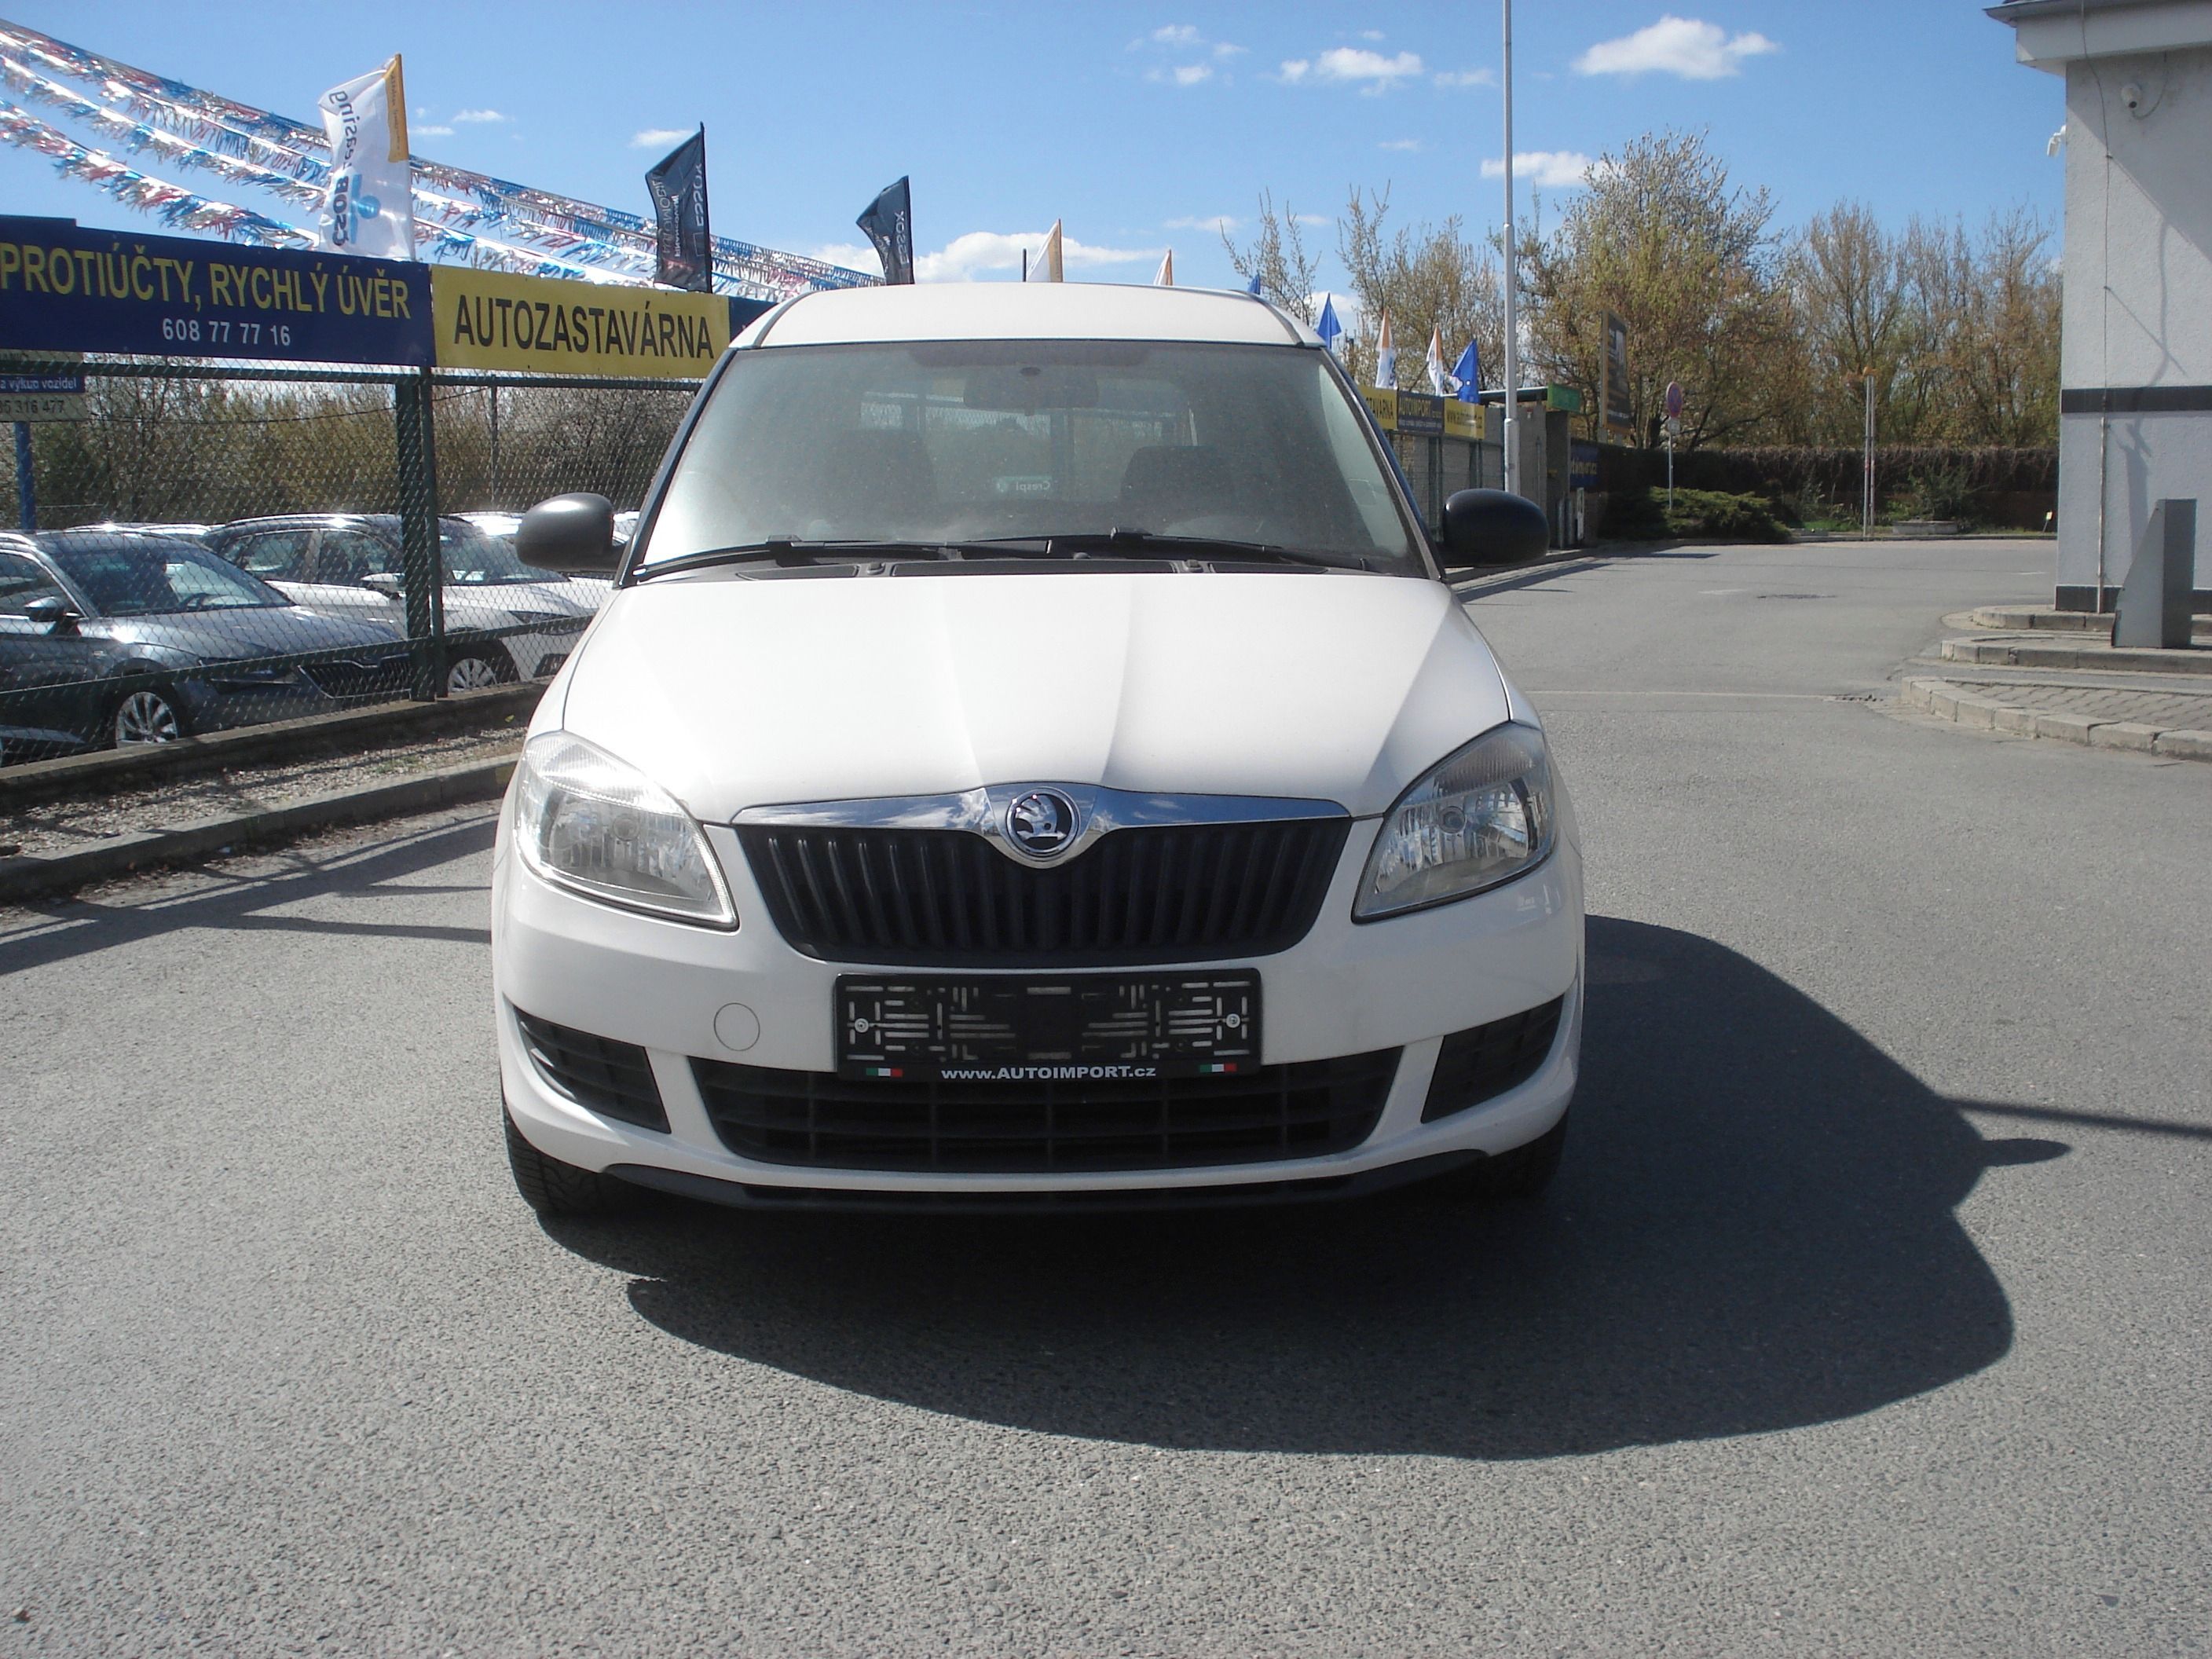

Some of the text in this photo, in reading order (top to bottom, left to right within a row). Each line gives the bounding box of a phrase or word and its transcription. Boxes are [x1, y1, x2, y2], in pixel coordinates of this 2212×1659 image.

[0, 243, 411, 320] PROTIÚČTY, RYCHLÝ ÚVĚR
[163, 318, 291, 347] 608 77 77 16
[454, 295, 715, 360] AUTOZASTAVÁRNA
[941, 1065, 1156, 1080] www.AUTOIMPORT.cz
